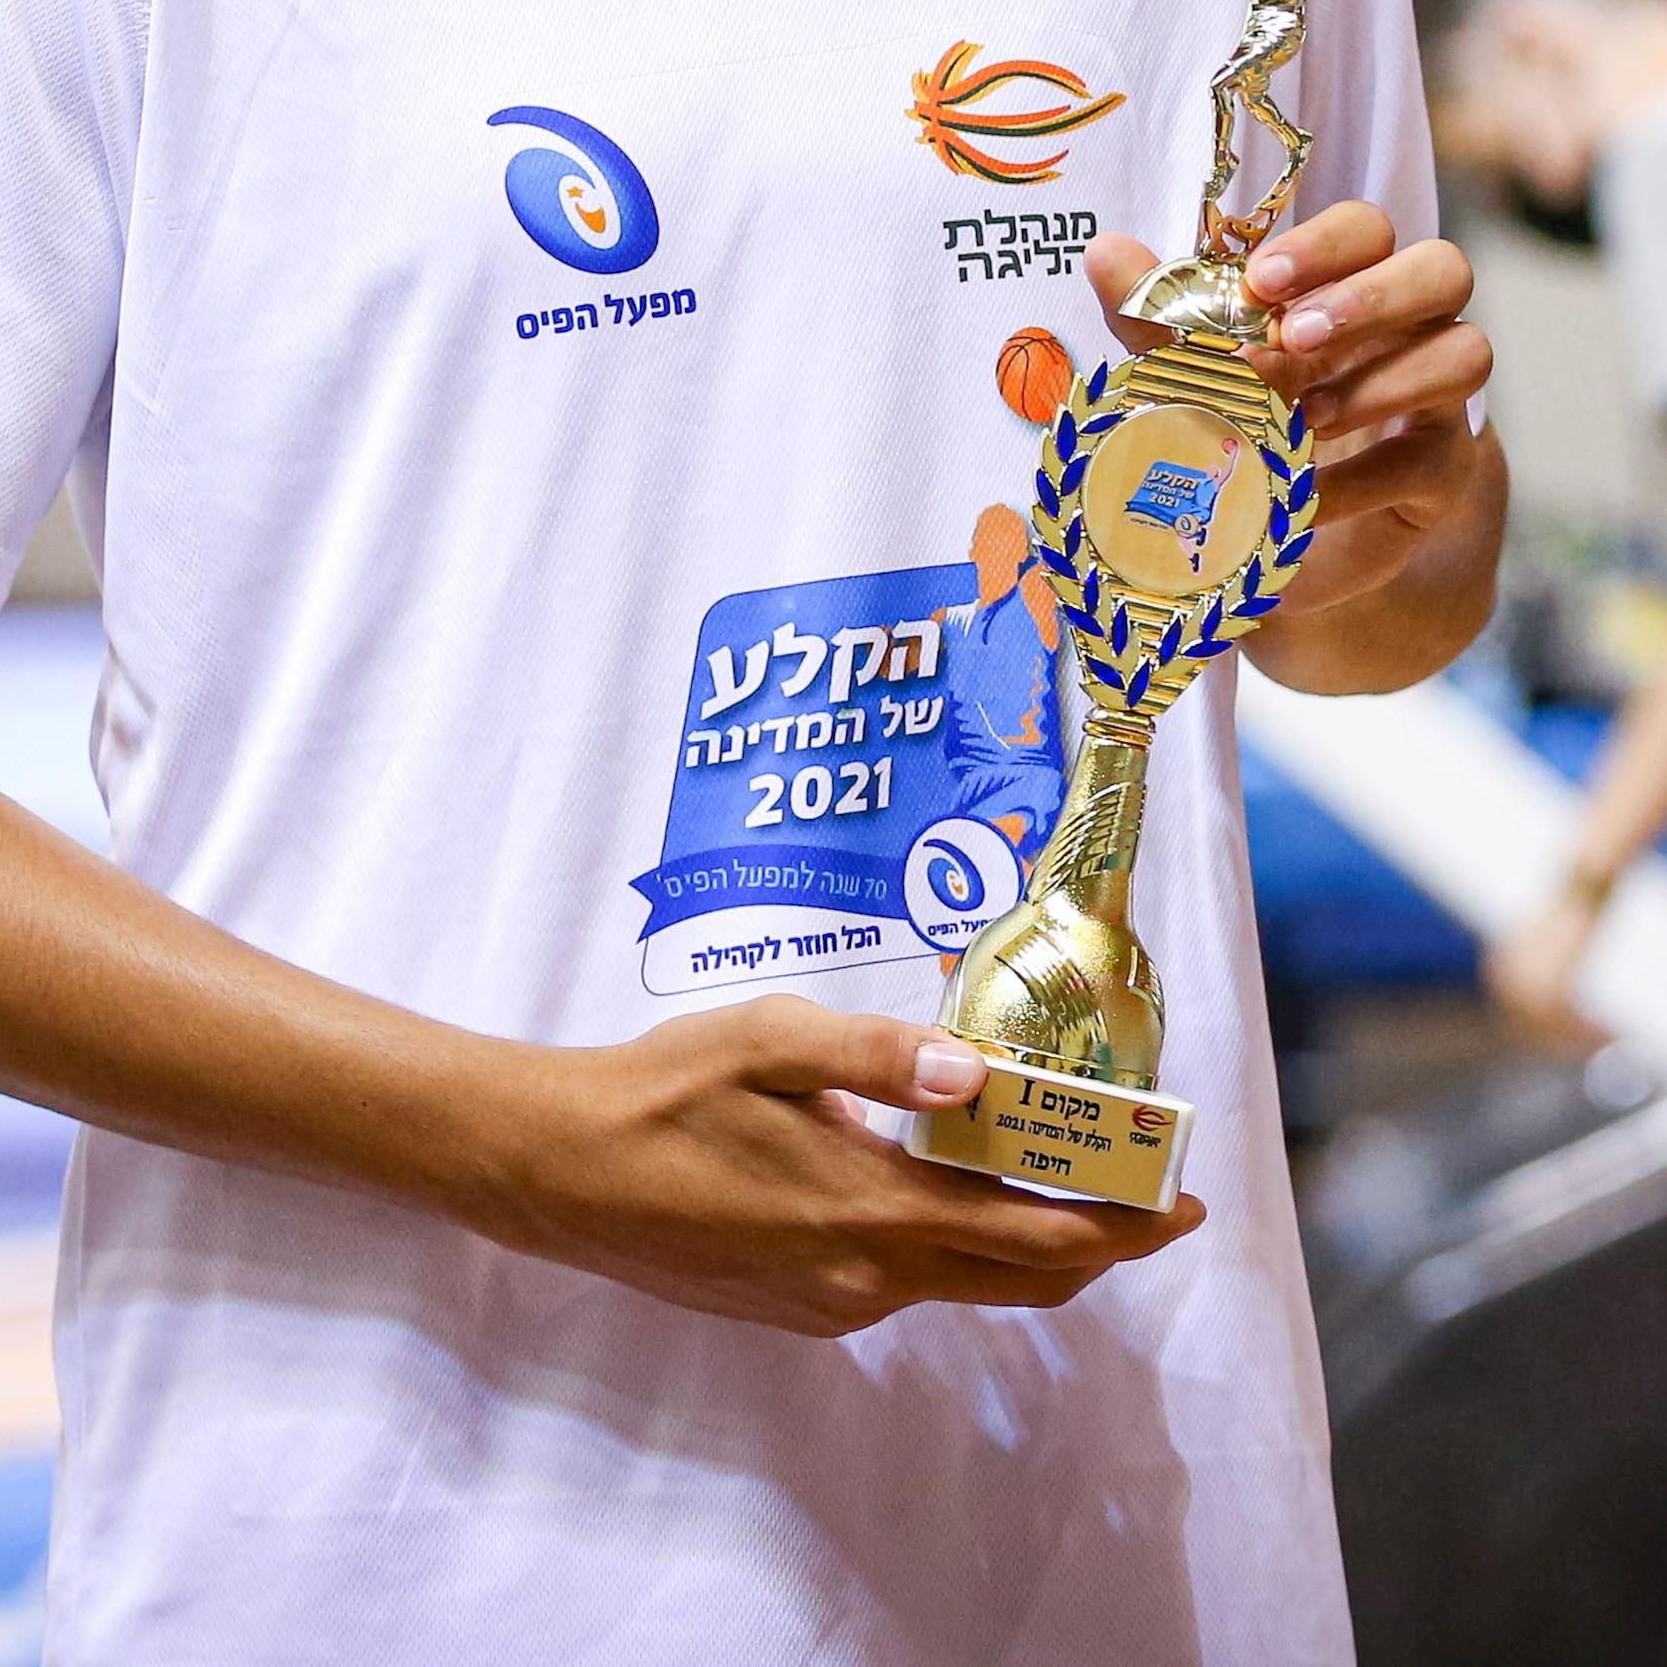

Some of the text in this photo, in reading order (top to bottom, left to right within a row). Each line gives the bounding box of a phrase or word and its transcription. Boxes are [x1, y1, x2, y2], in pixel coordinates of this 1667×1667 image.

[942, 208, 1097, 250] מנהלת
[516, 288, 697, 340] מפעל הפיס
[1149, 492, 1180, 508] 2021
[700, 619, 942, 721] הקלע
[685, 694, 945, 768] של המדינה
[744, 756, 893, 829] 2021
[733, 859, 816, 893] למפעל
[819, 871, 861, 897] שנה
[864, 878, 888, 900] 70
[690, 924, 882, 973] הכל חוזר לקהילה
[1040, 1090, 1100, 1121] מקום
[996, 1113, 1026, 1132] 2021
[1082, 1129, 1112, 1152] הקלע
[1021, 1149, 1072, 1176] חיפה
